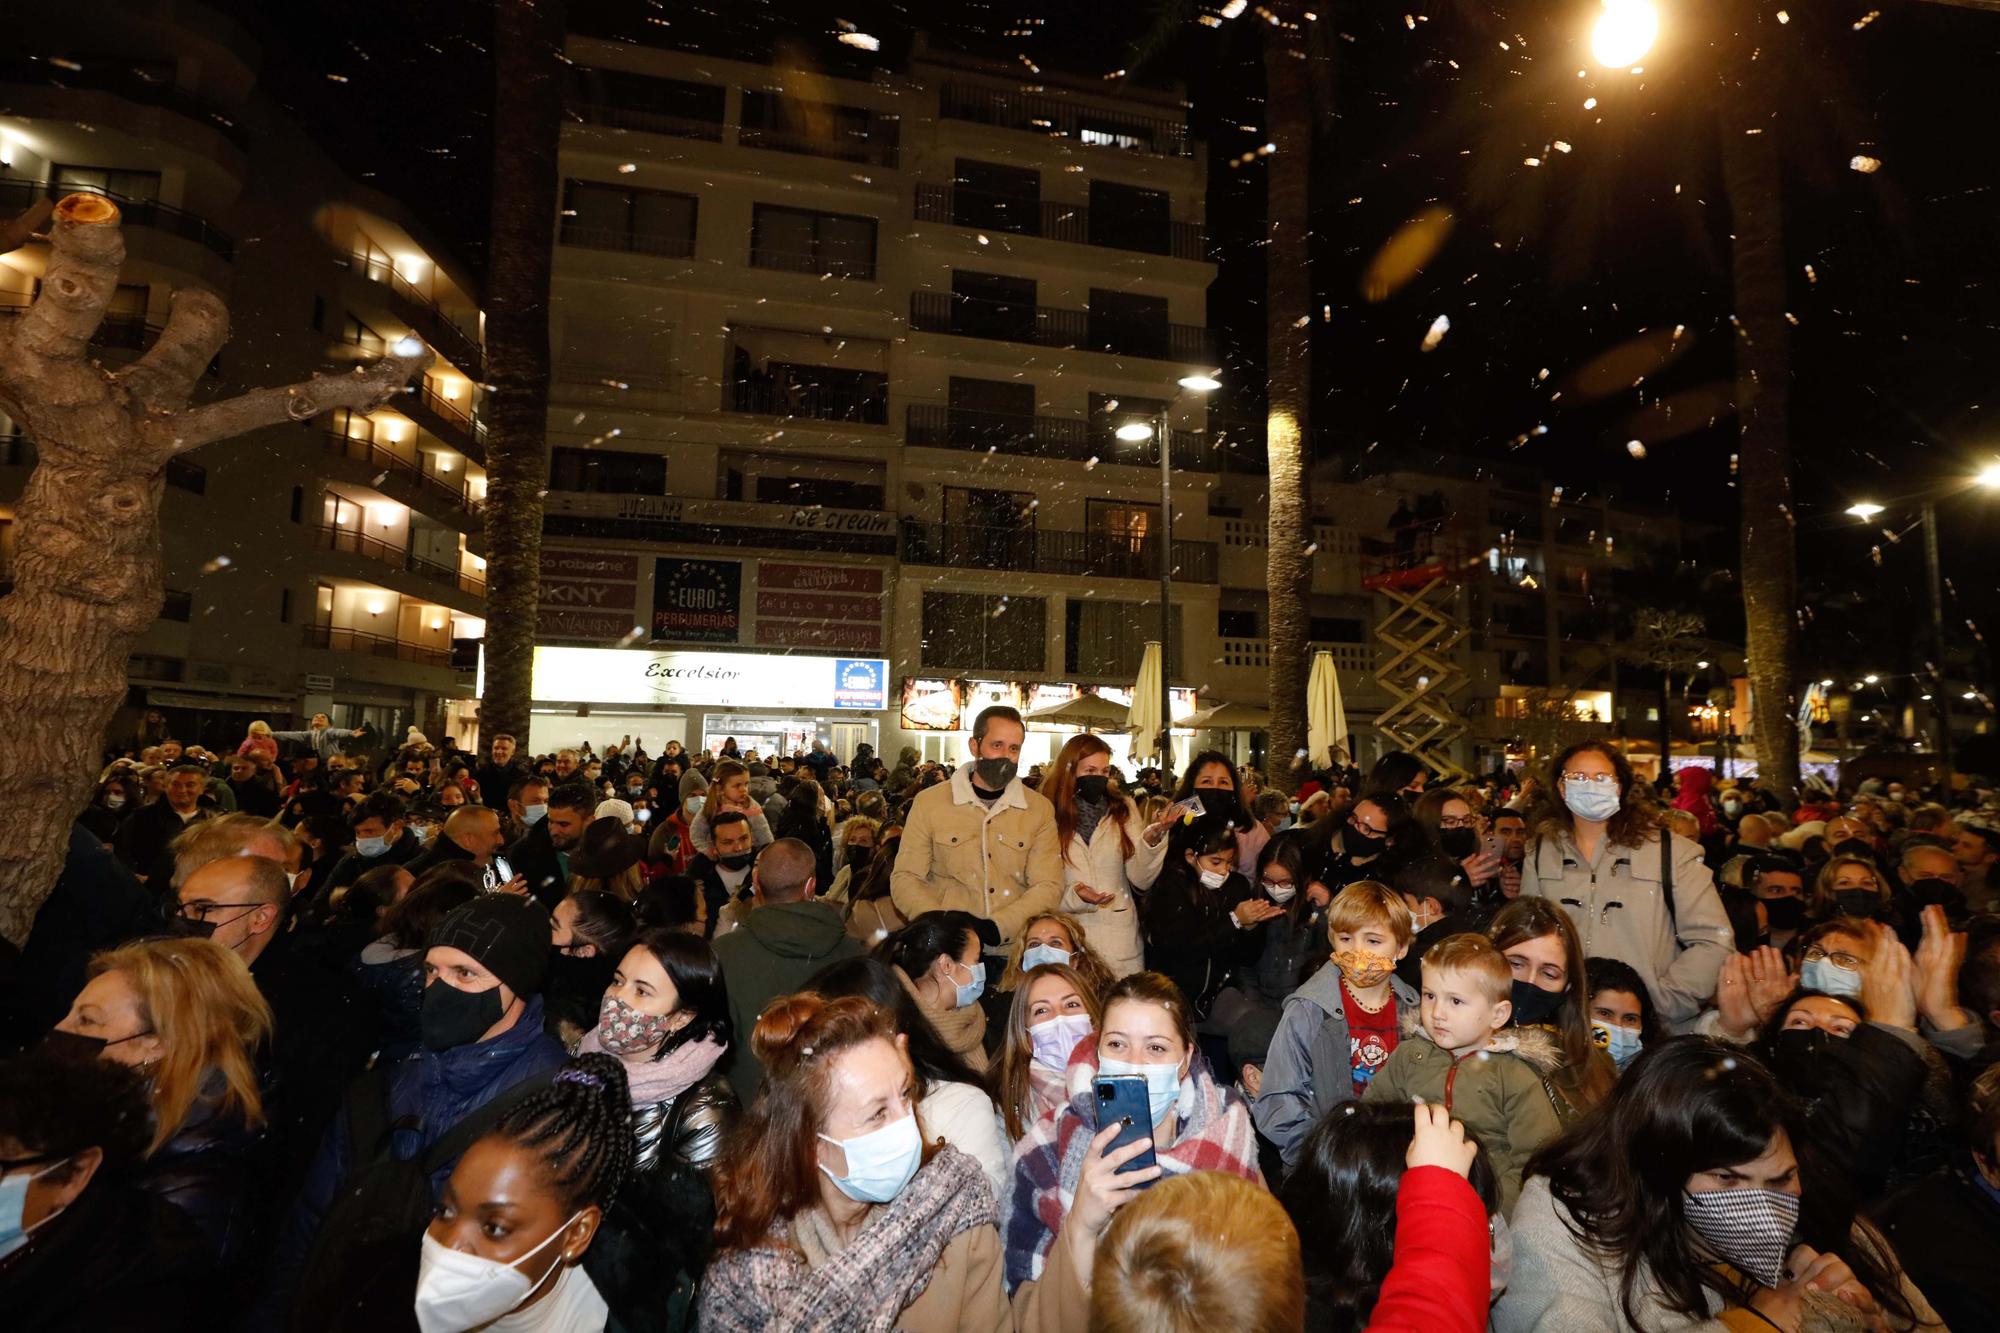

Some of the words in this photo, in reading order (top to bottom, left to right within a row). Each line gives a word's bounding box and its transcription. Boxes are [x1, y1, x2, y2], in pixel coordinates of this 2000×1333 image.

[824, 511, 888, 532] cream
[678, 587, 716, 609] EURO
[645, 662, 741, 680] Excelsior
